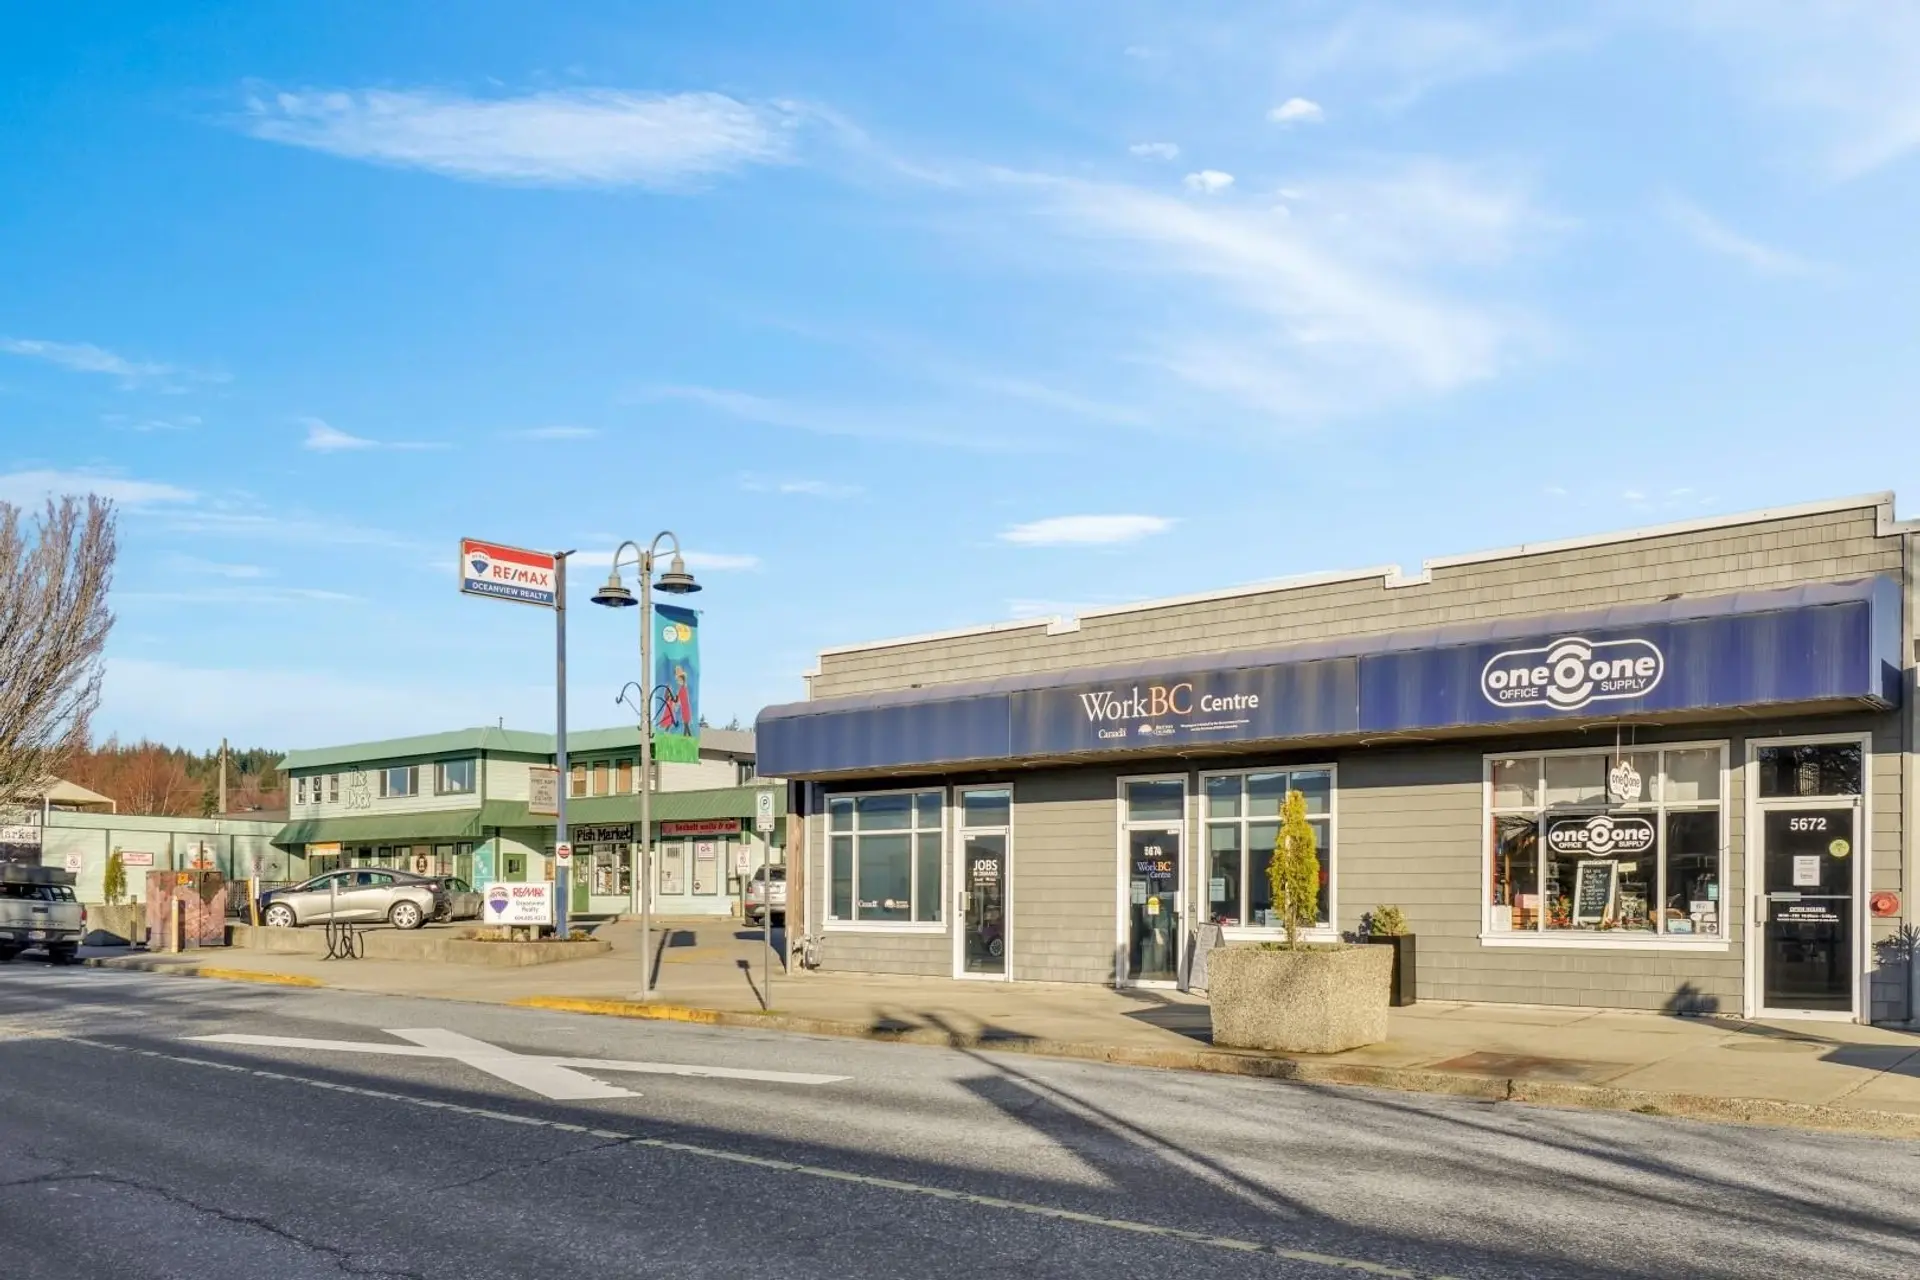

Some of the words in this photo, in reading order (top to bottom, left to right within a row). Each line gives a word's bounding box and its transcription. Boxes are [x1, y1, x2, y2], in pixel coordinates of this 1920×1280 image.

[493, 565, 548, 586] RE/MAX
[472, 581, 518, 597] OCEANVIEW
[520, 589, 548, 601] REALTY
[1488, 666, 1549, 689] one
[1588, 656, 1656, 681] one
[1499, 687, 1539, 701] OFFICE
[1601, 678, 1647, 692] SUPPLY
[1079, 682, 1194, 722] WorkBC
[1200, 693, 1260, 713] Centre
[1790, 817, 1828, 831] 5672
[576, 828, 595, 842] Fish
[597, 827, 631, 842] Market
[1551, 830, 1590, 842] one
[1610, 828, 1651, 841] one
[1558, 841, 1583, 849] OFFICE
[1618, 841, 1645, 849] SUPPLY
[973, 859, 998, 871] JOBS
[512, 886, 545, 898] RE/MAX
